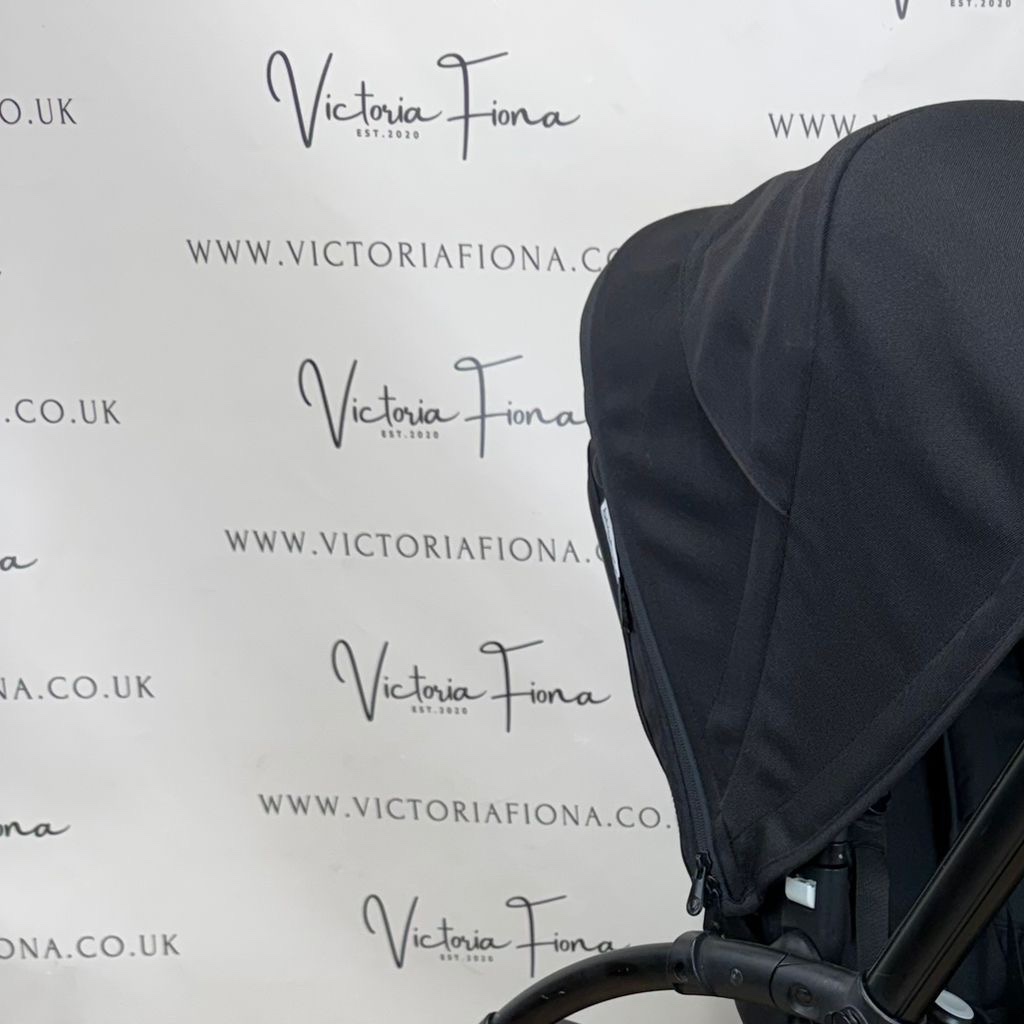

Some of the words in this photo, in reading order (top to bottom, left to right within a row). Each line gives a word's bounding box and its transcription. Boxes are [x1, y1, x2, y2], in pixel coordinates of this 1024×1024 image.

[266, 50, 443, 149] Victoria
[436, 51, 581, 161] Fiona
[356, 128, 419, 140] EST.2020
[298, 358, 460, 449] Victoria
[454, 355, 587, 459] Fiona
[330, 639, 487, 722] Victoria
[478, 640, 611, 733] Fiona
[362, 894, 512, 970] Victoria
[505, 894, 631, 978] Fiona
